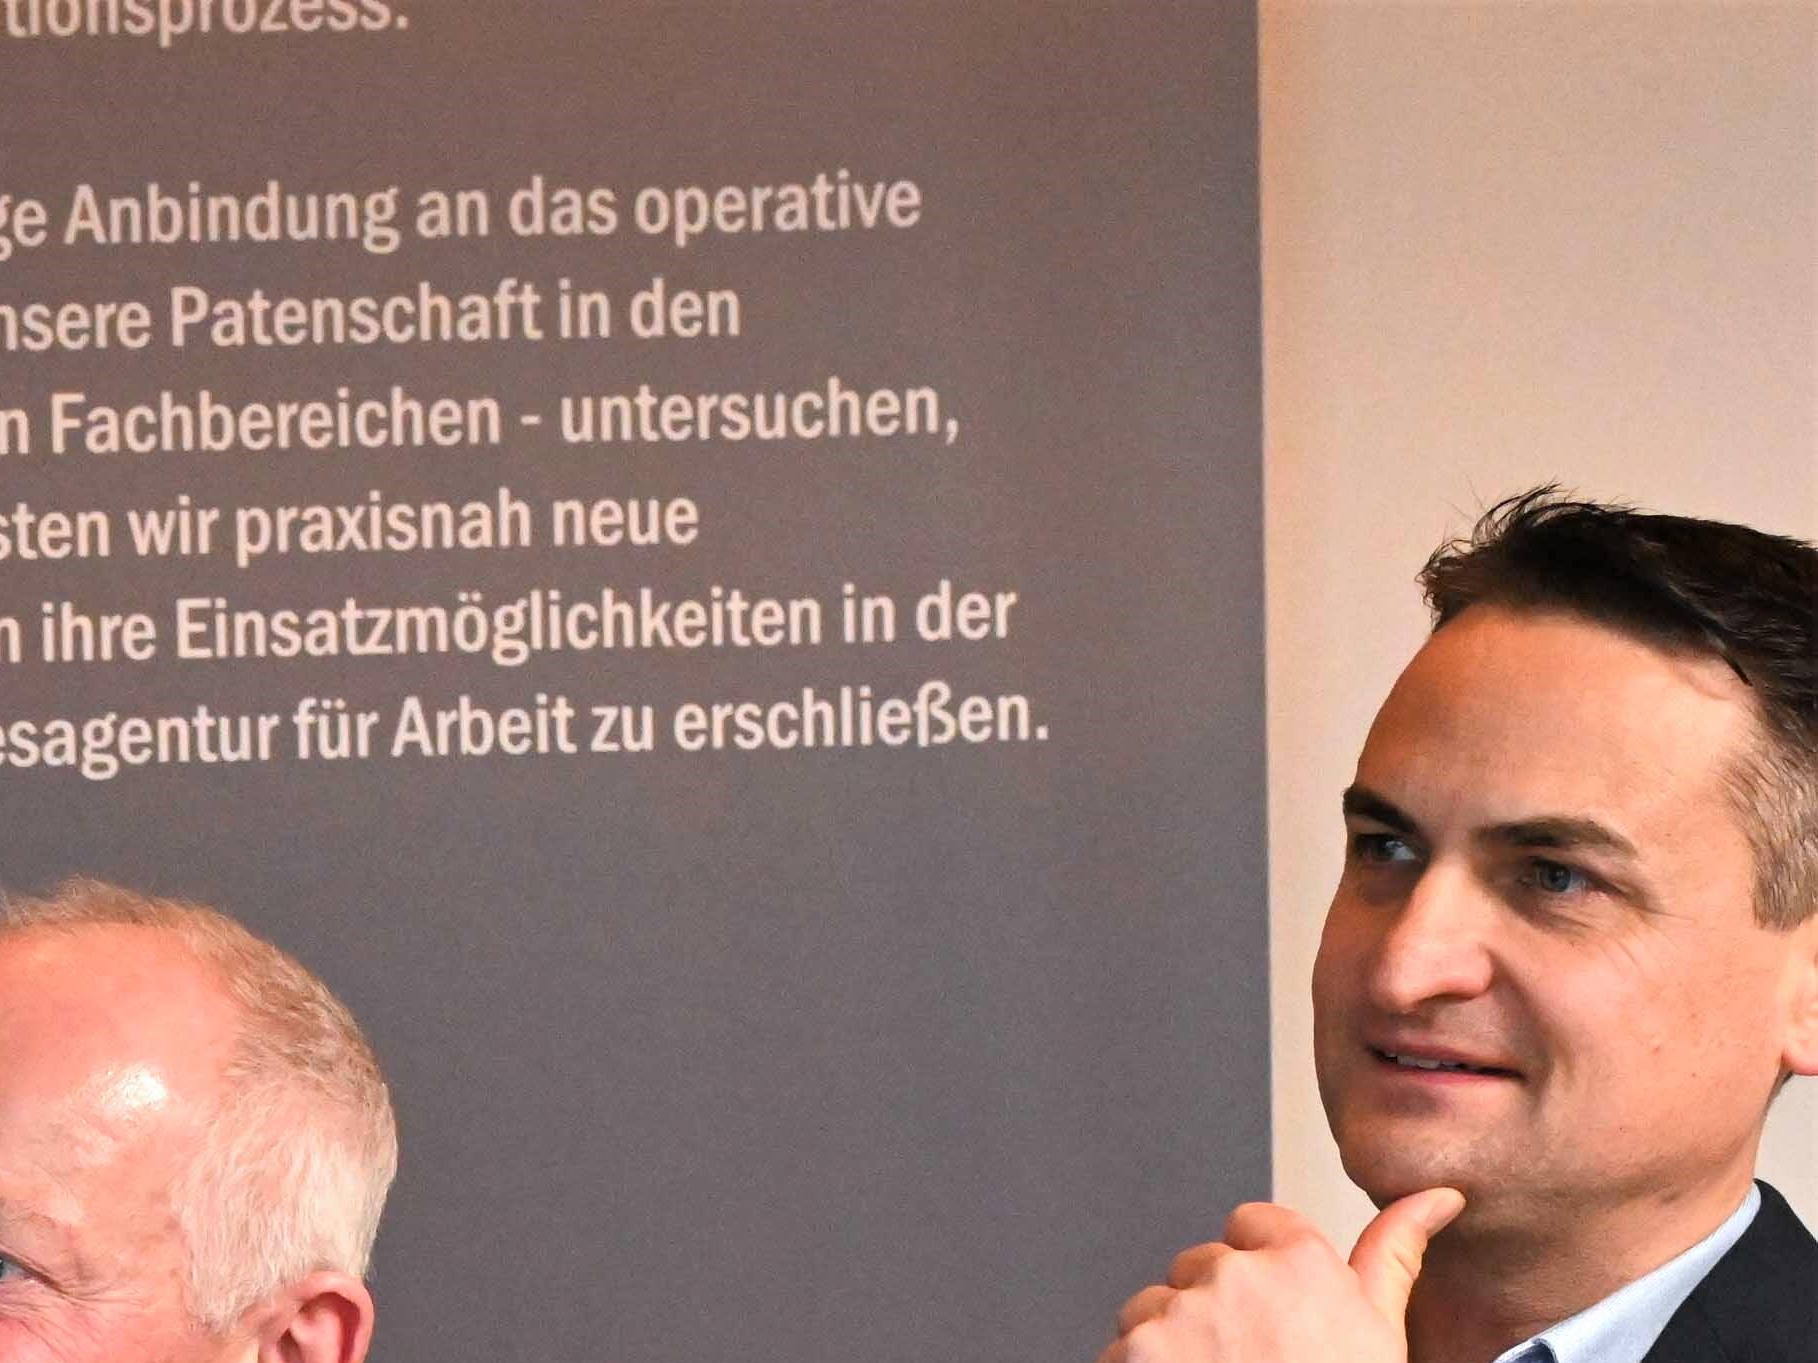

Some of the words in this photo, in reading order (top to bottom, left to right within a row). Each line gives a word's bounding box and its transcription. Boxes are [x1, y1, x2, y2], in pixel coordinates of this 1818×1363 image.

[64, 180, 400, 254] Anbindung
[416, 189, 489, 238] an
[509, 174, 618, 236] das
[635, 168, 922, 248] operative
[170, 277, 544, 347] Patenschaft
[559, 277, 611, 339] in
[630, 277, 740, 339] den
[51, 385, 501, 454] Fachbereichen
[561, 375, 959, 446] untersuchen,
[127, 494, 220, 556] wir
[236, 486, 531, 569] praxisnah
[552, 497, 699, 546] neue
[42, 601, 157, 663] ihre
[176, 585, 821, 667] Einsatzmöglichkeiten
[842, 582, 895, 643] in
[915, 578, 1018, 642] der
[292, 697, 379, 760] für
[390, 693, 578, 758] Arbeit
[590, 705, 654, 753] zu
[673, 680, 1049, 751] erschließen.
